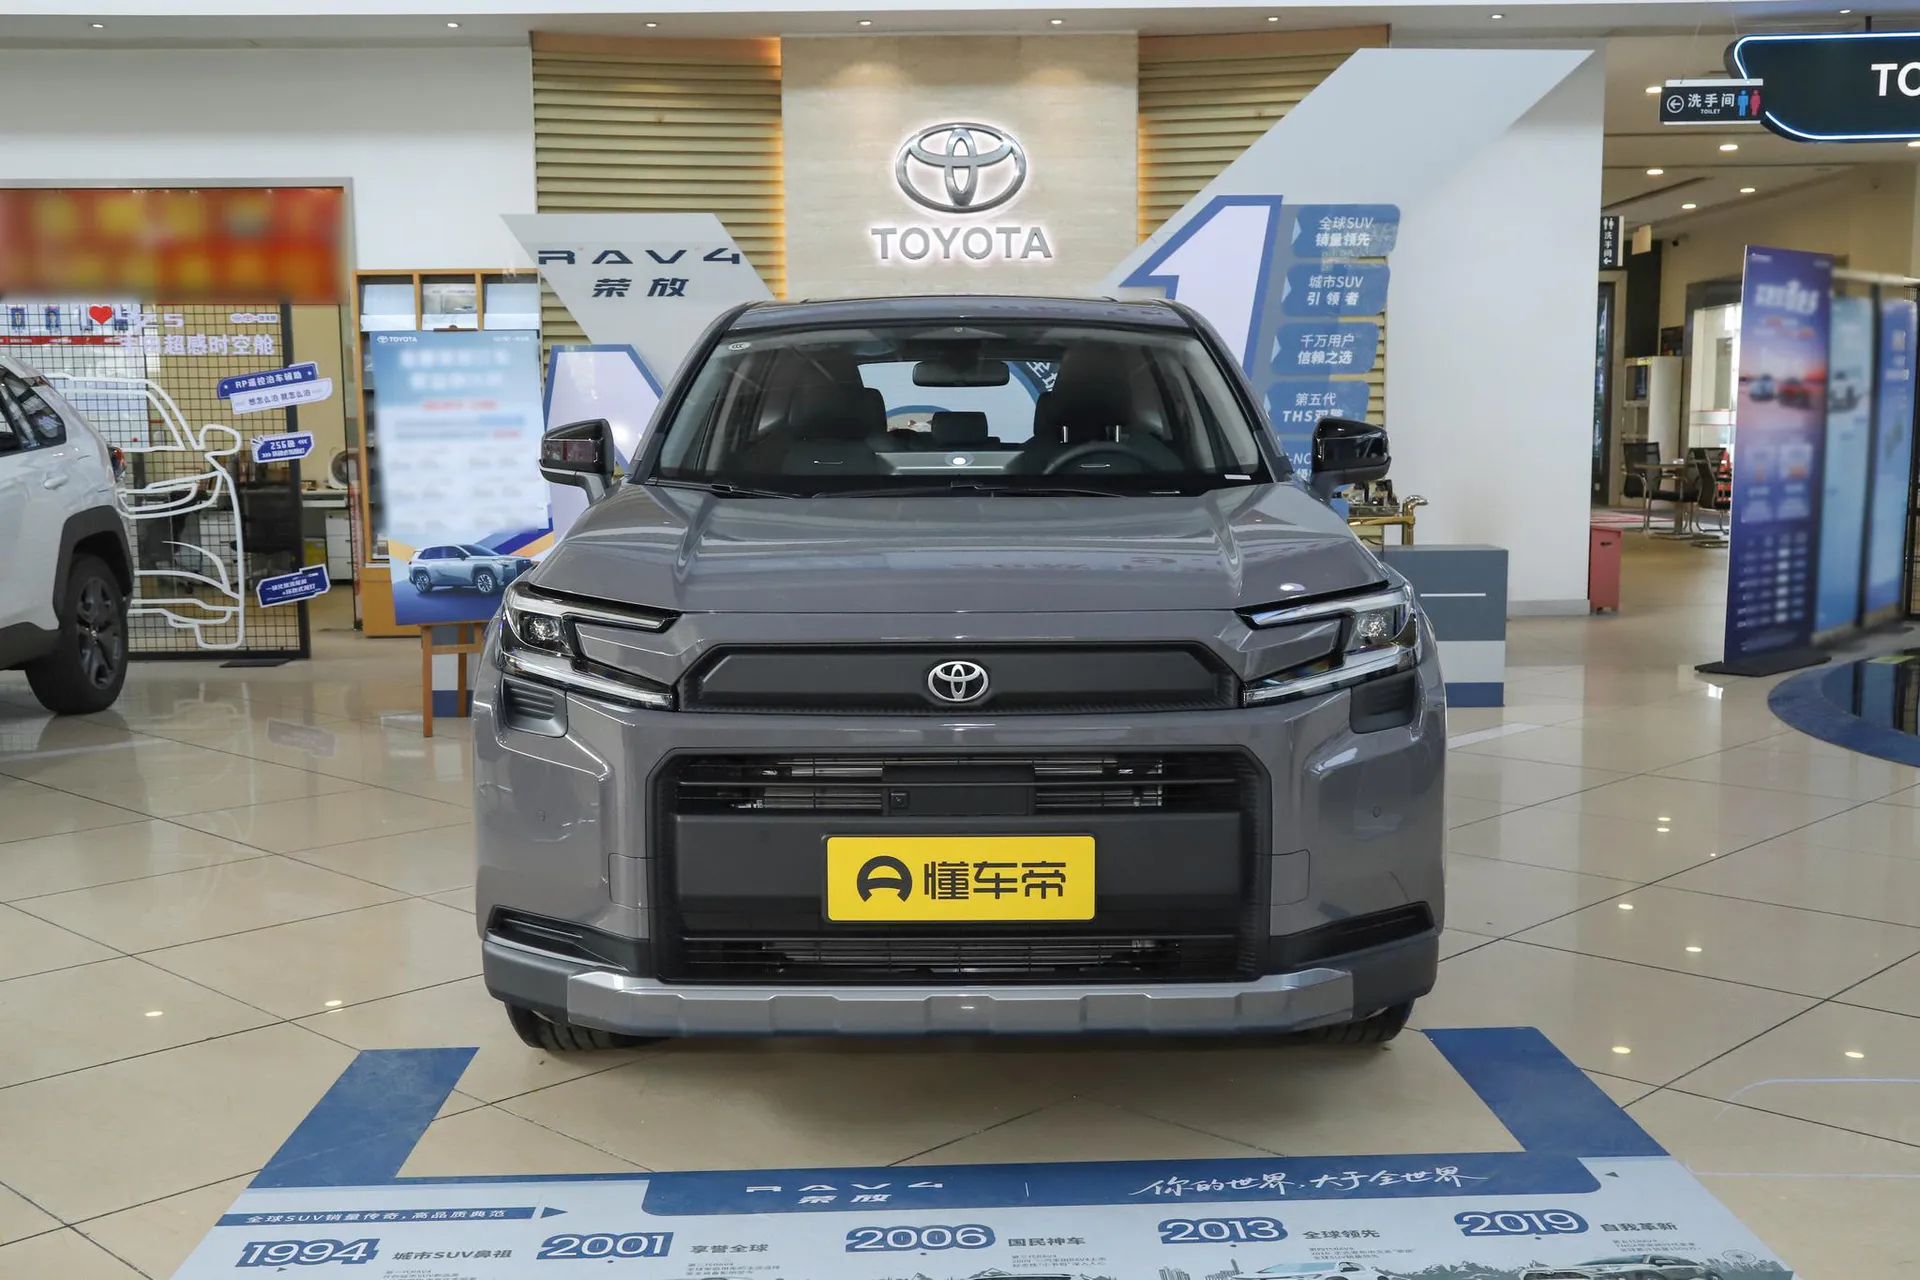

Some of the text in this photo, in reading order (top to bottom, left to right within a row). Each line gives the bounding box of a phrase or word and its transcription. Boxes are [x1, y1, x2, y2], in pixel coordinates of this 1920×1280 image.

[1687, 93, 1735, 108] 洗手间
[1318, 216, 1374, 231] 全球SUV
[871, 226, 1053, 260] TOYOTA
[1315, 232, 1371, 248] 销量领先
[1603, 231, 1613, 258] 洗手间
[537, 247, 741, 265] RAV4
[591, 277, 690, 298] 荣放
[1308, 275, 1364, 289] 城市SUV
[1306, 291, 1360, 306] 引领者
[1300, 333, 1355, 348] 千万用户
[1297, 350, 1354, 365] 信赖之选
[1295, 391, 1337, 407] 第五代
[923, 860, 1067, 900] 懂车帝
[745, 1181, 944, 1193] RAV4
[797, 1193, 892, 1204] 荣放
[1461, 1210, 1581, 1235] 2019
[1599, 1221, 1679, 1233] 自我革新
[852, 1226, 989, 1250] 2006
[1164, 1219, 1281, 1242] 2013
[1301, 1227, 1381, 1240] 全球领先
[544, 1234, 666, 1257] 2001
[689, 1243, 769, 1254] 享誉全球
[1007, 1236, 1086, 1247] 国民神车
[245, 1240, 370, 1265] 1994
[391, 1249, 513, 1261] 城市SUV鼻祖
